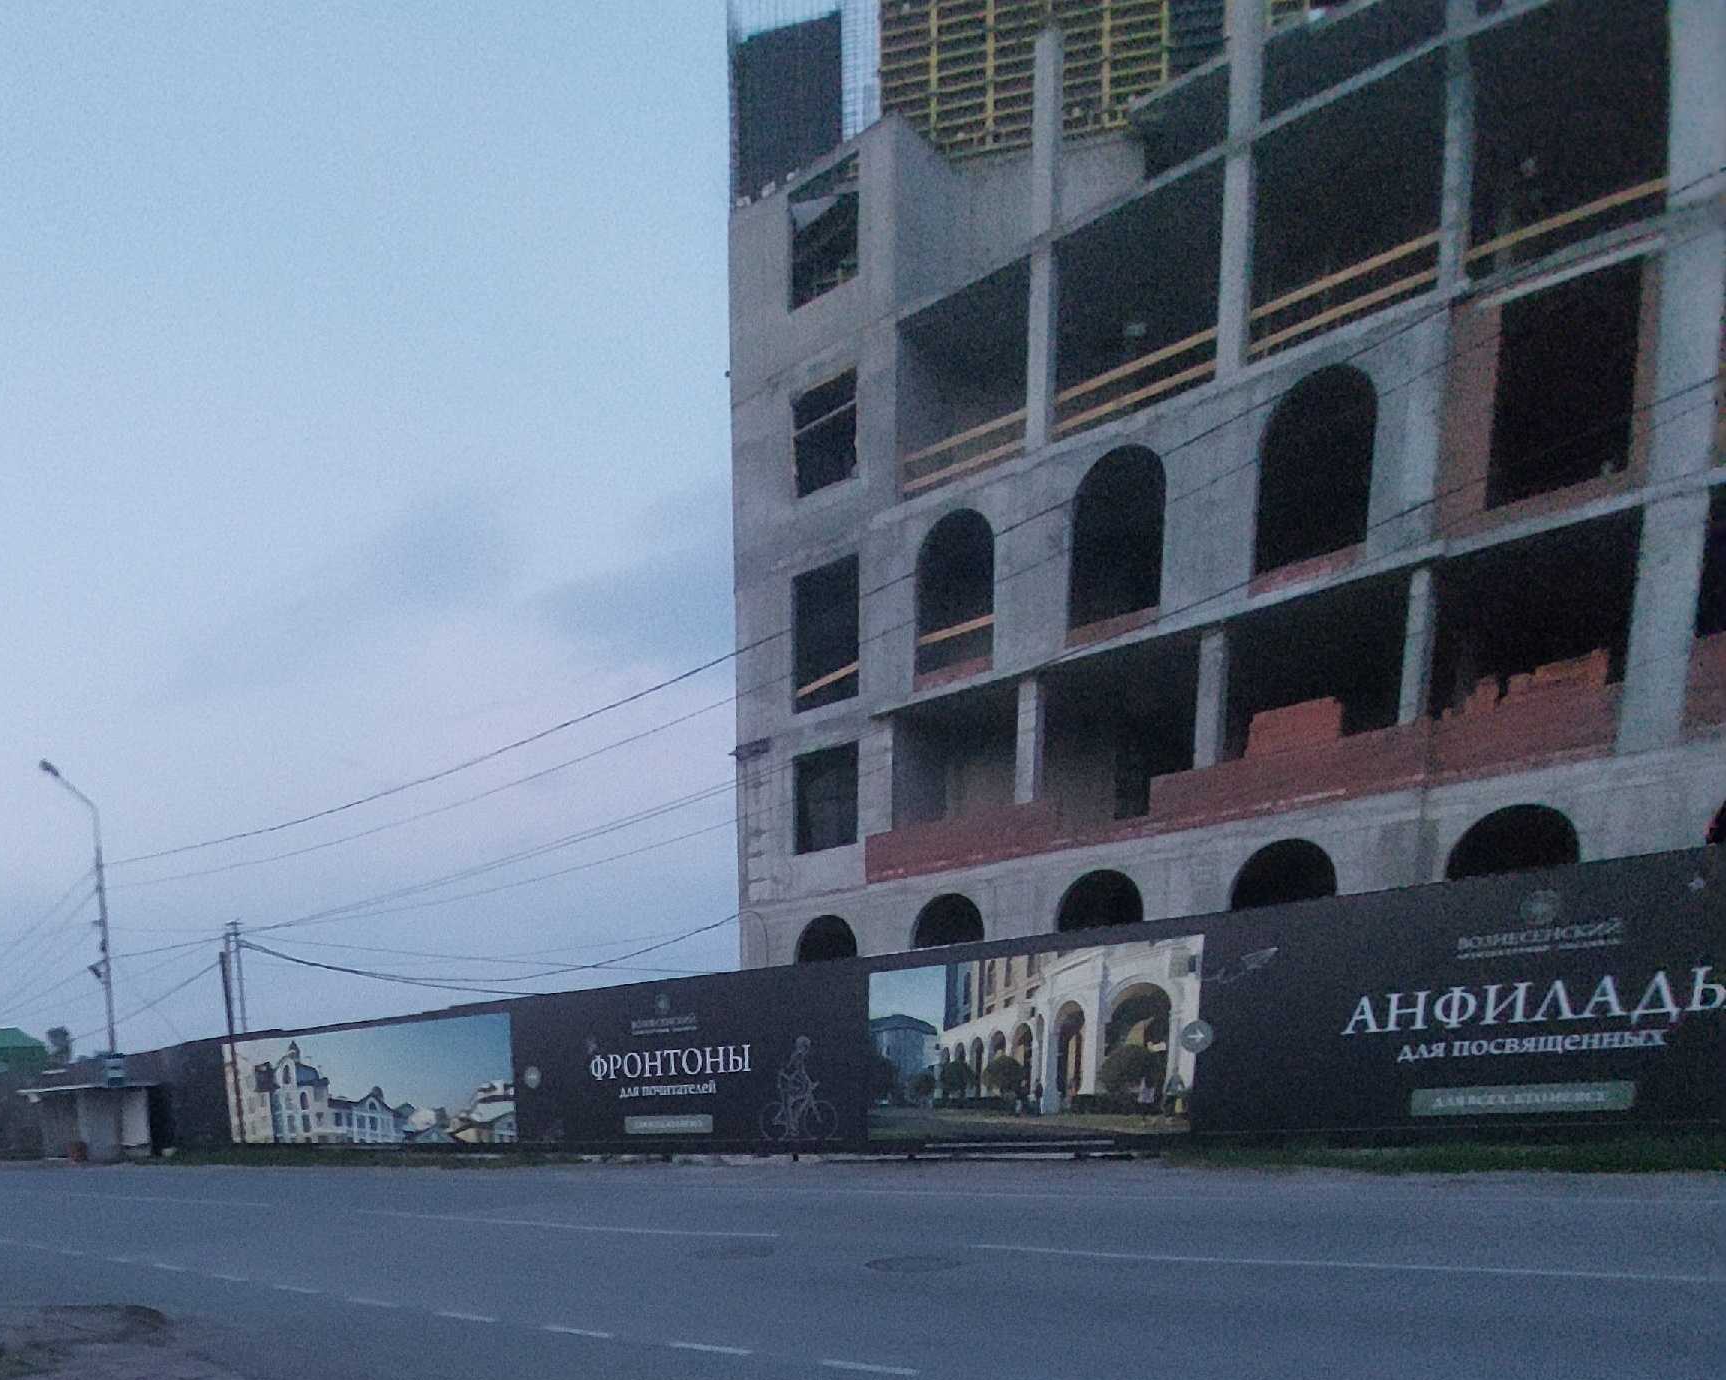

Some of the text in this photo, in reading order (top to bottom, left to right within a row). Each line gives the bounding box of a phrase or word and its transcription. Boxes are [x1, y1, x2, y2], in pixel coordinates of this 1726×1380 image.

[590, 1043, 751, 1083] ФРОНТОНЫ
[1397, 1029, 1666, 1064] для посвященных
[619, 1080, 716, 1099] для почитателей
